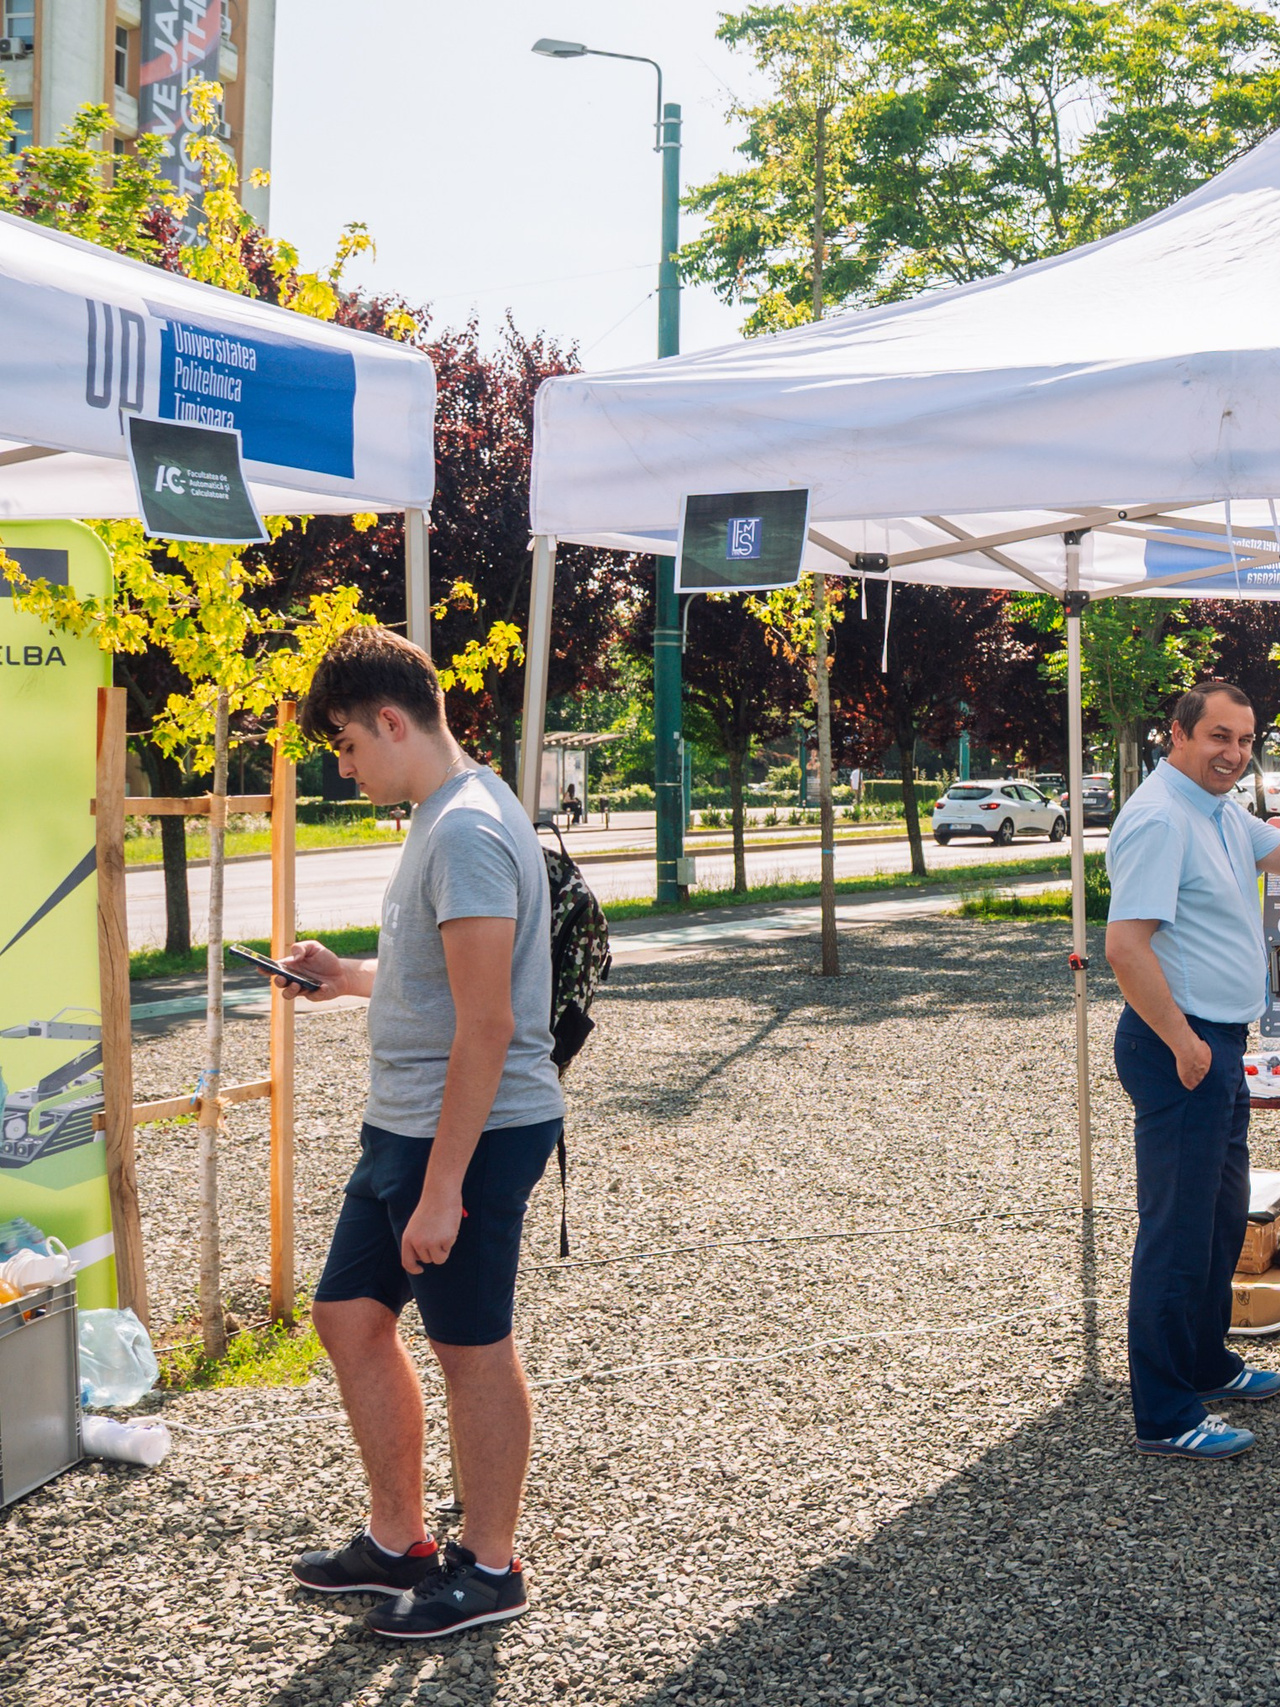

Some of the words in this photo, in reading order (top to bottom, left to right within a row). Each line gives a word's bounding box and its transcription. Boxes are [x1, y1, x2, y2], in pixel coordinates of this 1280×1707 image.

[172, 321, 257, 371] Universitatea
[173, 356, 243, 403] Politehnica
[187, 469, 219, 481] Facultatea
[190, 488, 229, 500] Calculatoare
[0, 645, 67, 666] LBA
